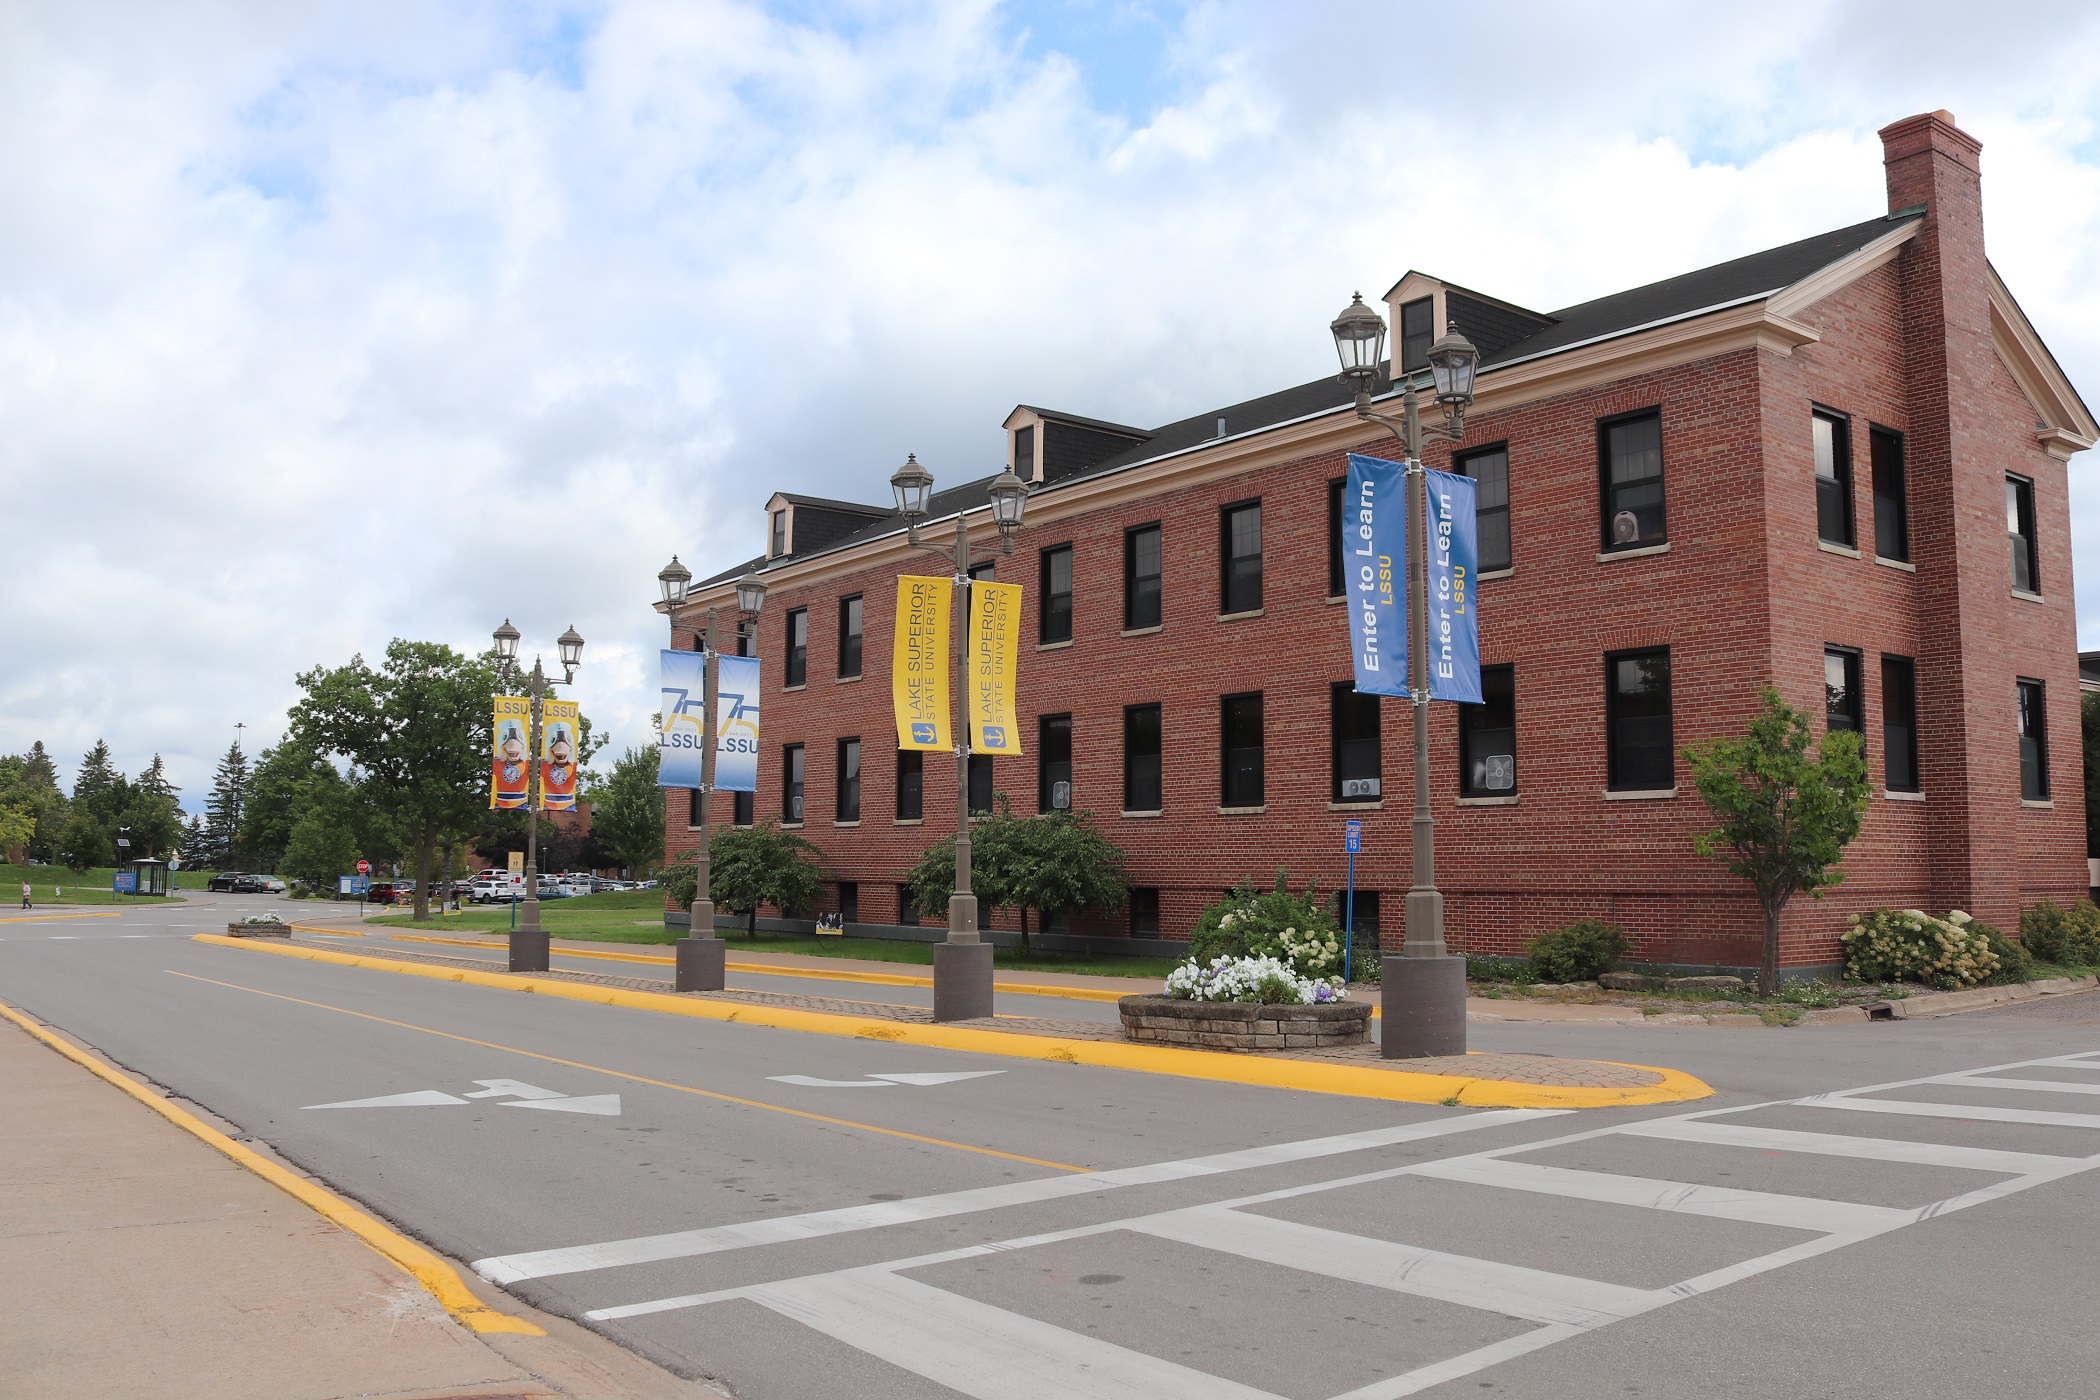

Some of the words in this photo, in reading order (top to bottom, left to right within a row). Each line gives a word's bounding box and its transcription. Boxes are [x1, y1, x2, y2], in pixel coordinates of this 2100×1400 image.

[1355, 480, 1375, 557] Learn
[1437, 493, 1452, 567] Learn
[1358, 565, 1374, 591] to
[1378, 555, 1393, 605] LSSU
[1437, 575, 1450, 601] to
[1453, 566, 1466, 615] LSSU
[908, 583, 925, 672] SUPERIOR
[925, 583, 938, 670] UNIVERSITY
[981, 589, 996, 675] SUPERIOR
[995, 590, 1008, 675] UNIVERSITY
[1362, 599, 1380, 672] Enter
[1438, 608, 1454, 679] Enter
[496, 702, 528, 714] LSSU
[545, 705, 577, 718] LSSU
[661, 687, 704, 735] 75
[718, 692, 760, 739] 75
[908, 678, 922, 719] LAKE
[925, 677, 936, 720] STATE
[981, 681, 993, 723] LAKE
[995, 681, 1004, 723] STATE
[661, 733, 704, 749] LSSU
[716, 737, 759, 754] LSSU
[1349, 839, 1357, 849] 15
